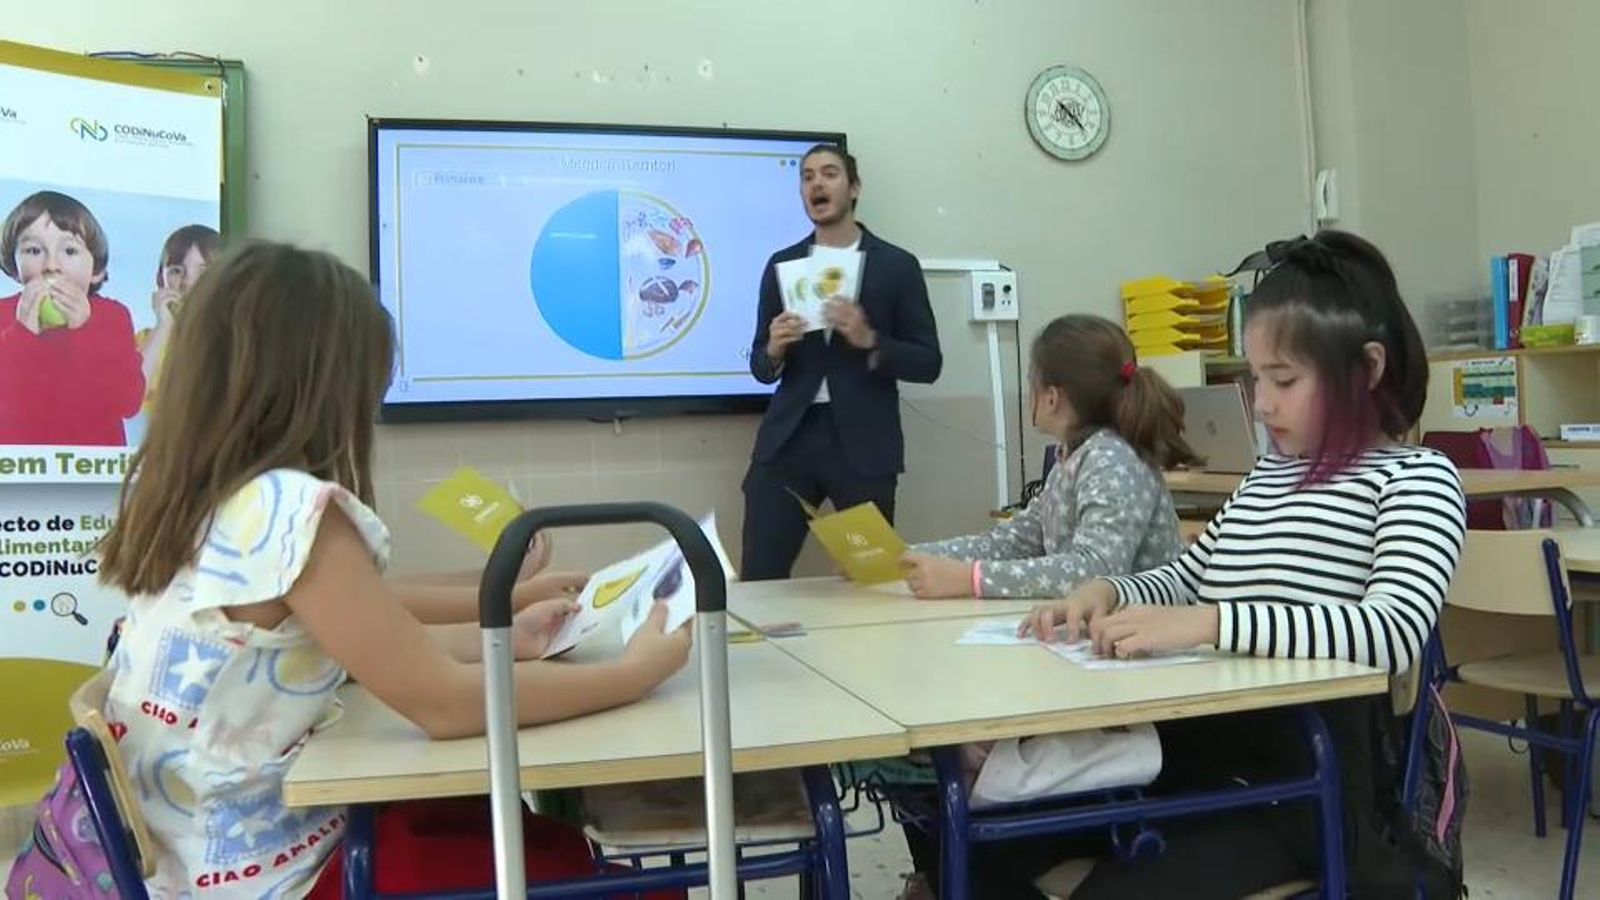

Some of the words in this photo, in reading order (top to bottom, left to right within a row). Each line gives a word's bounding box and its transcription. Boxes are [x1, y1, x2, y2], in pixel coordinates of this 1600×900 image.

[0, 516, 41, 532] cto
[46, 515, 75, 531] de
[196, 864, 262, 887] CIAO
